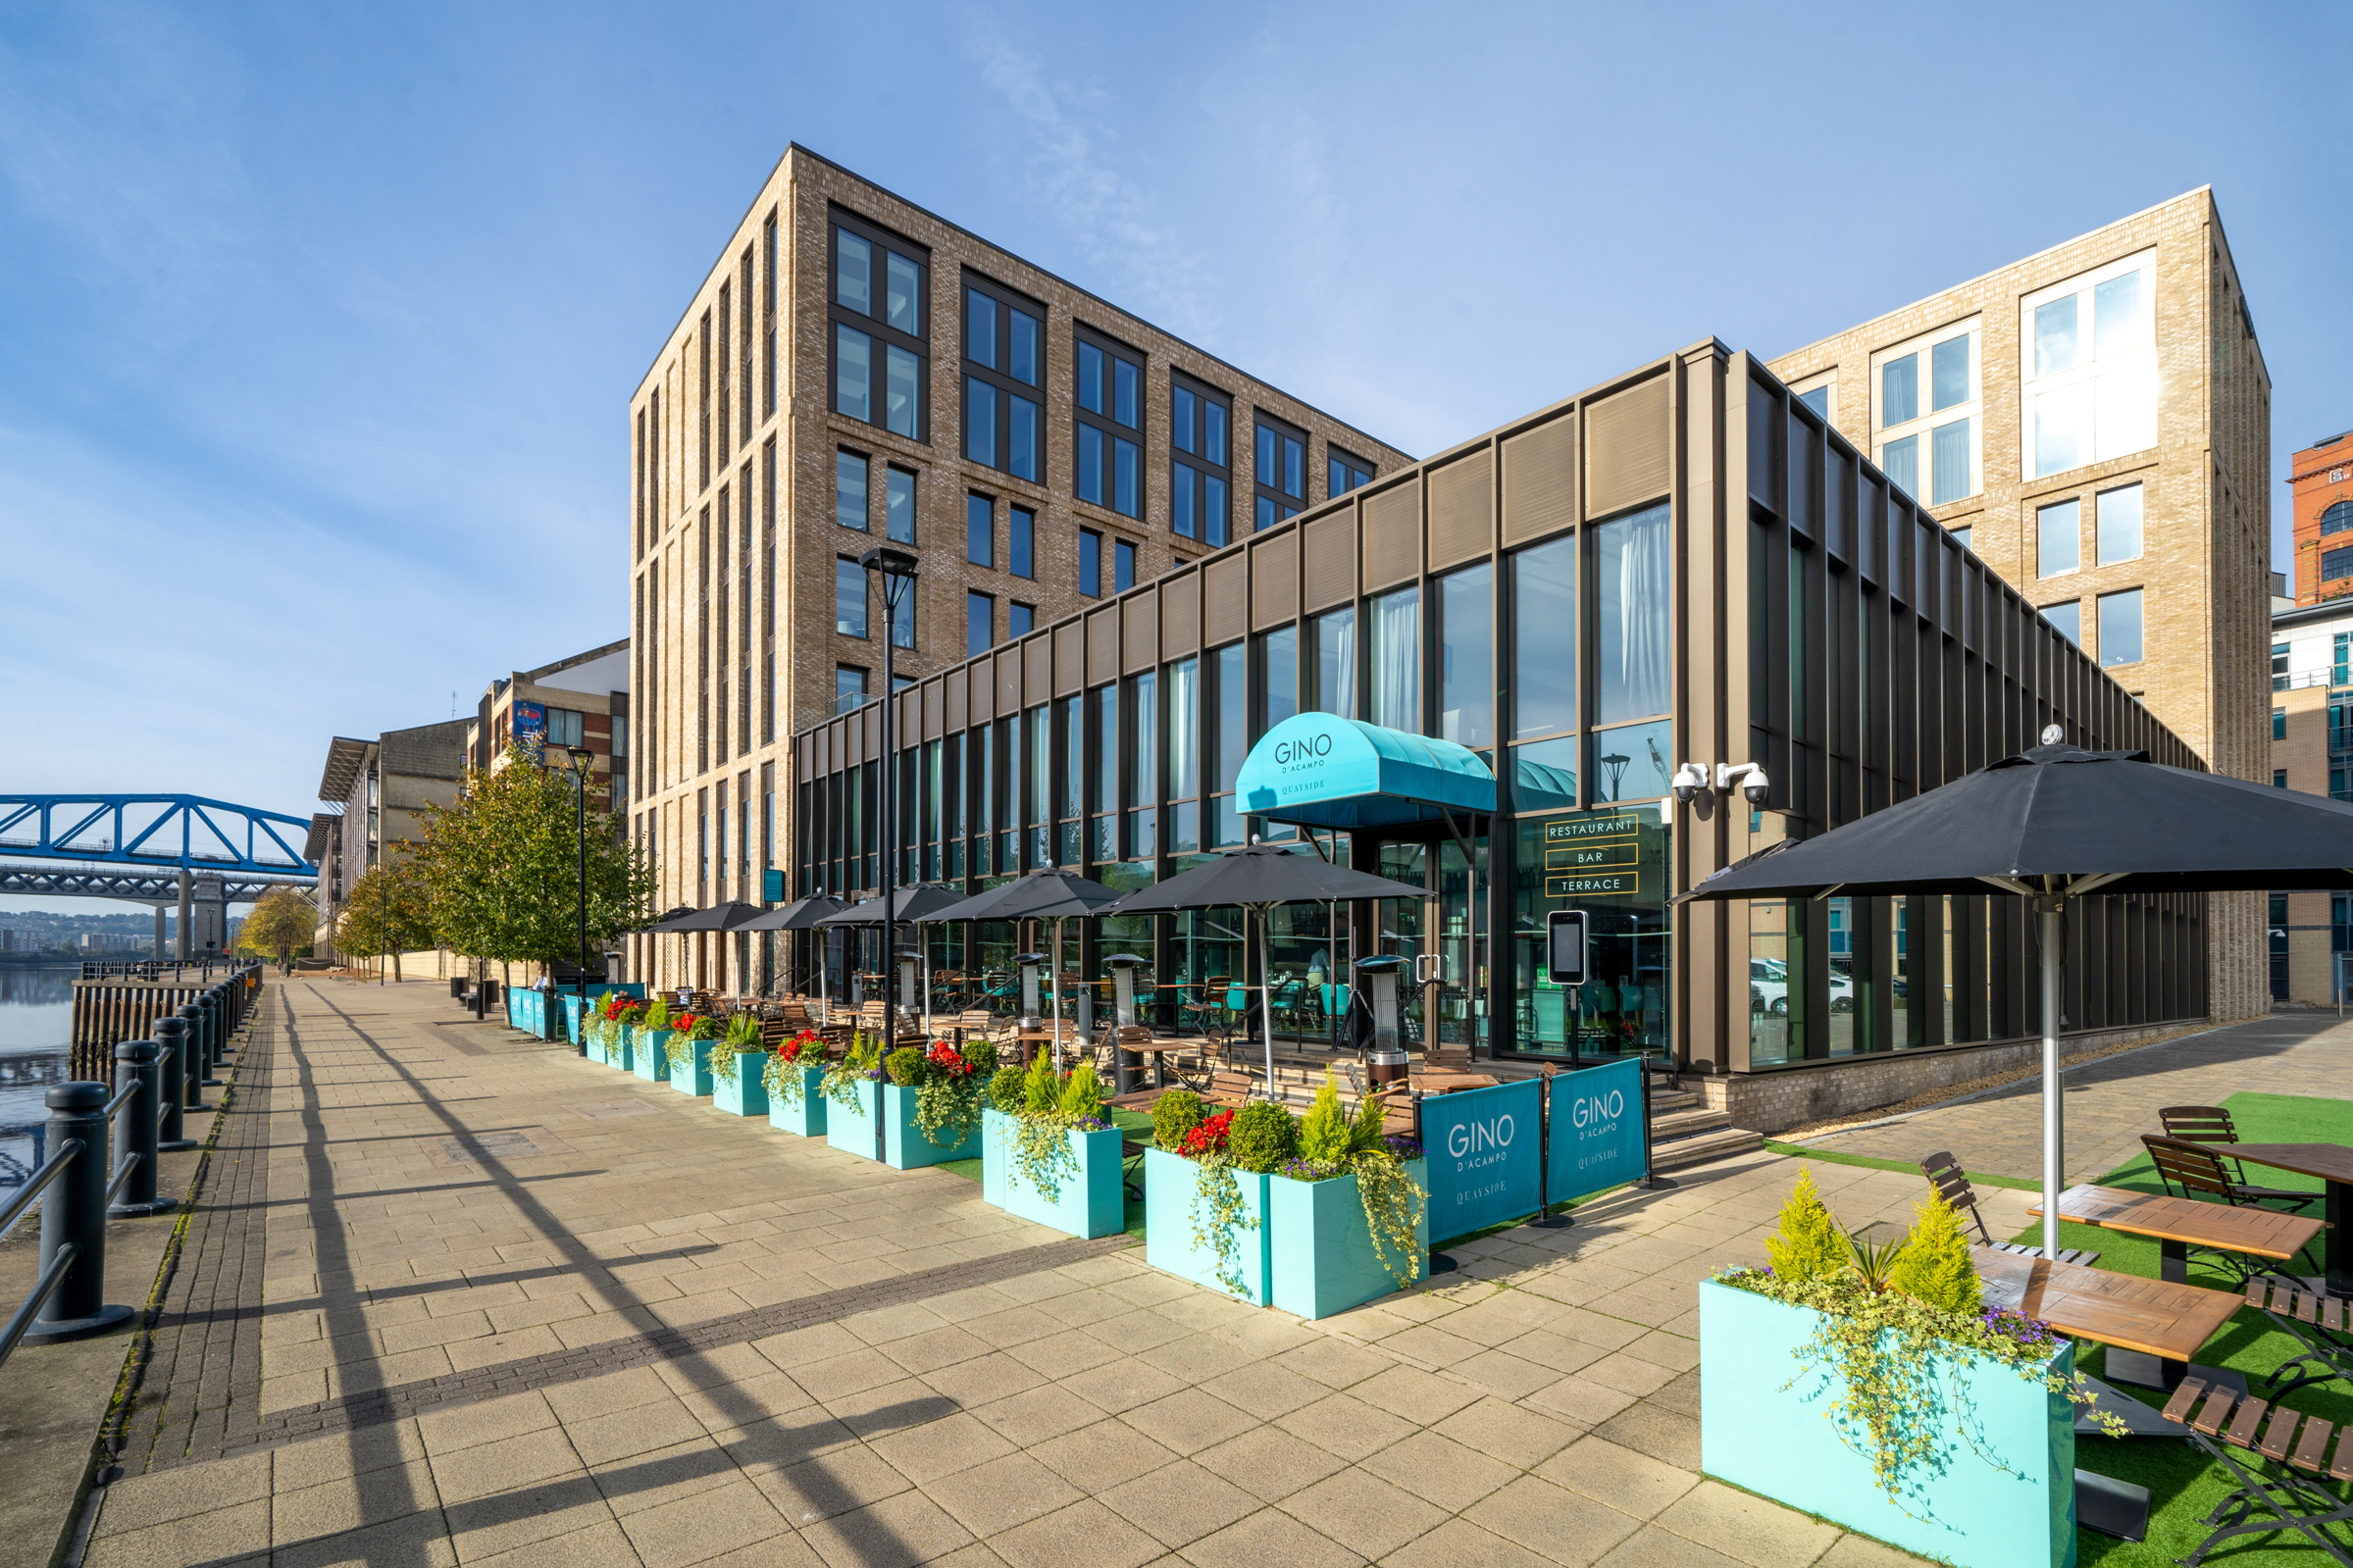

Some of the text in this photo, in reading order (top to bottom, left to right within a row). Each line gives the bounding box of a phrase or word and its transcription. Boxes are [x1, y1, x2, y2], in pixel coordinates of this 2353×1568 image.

[1275, 733, 1332, 764] GINO
[1282, 760, 1324, 774] D'ACAMPO
[1282, 781, 1325, 795] QUAYSIDE
[1550, 820, 1631, 837] RESTAURANT
[1577, 852, 1603, 863] BAR
[1561, 879, 1620, 891] TERRACE
[1572, 1089, 1624, 1129] GINO
[1448, 1114, 1514, 1158] GINO
[1579, 1123, 1617, 1140] D'ACAMPO
[1458, 1151, 1507, 1172] D'ACAMPO
[1457, 1181, 1507, 1205] QUAYSIDE
